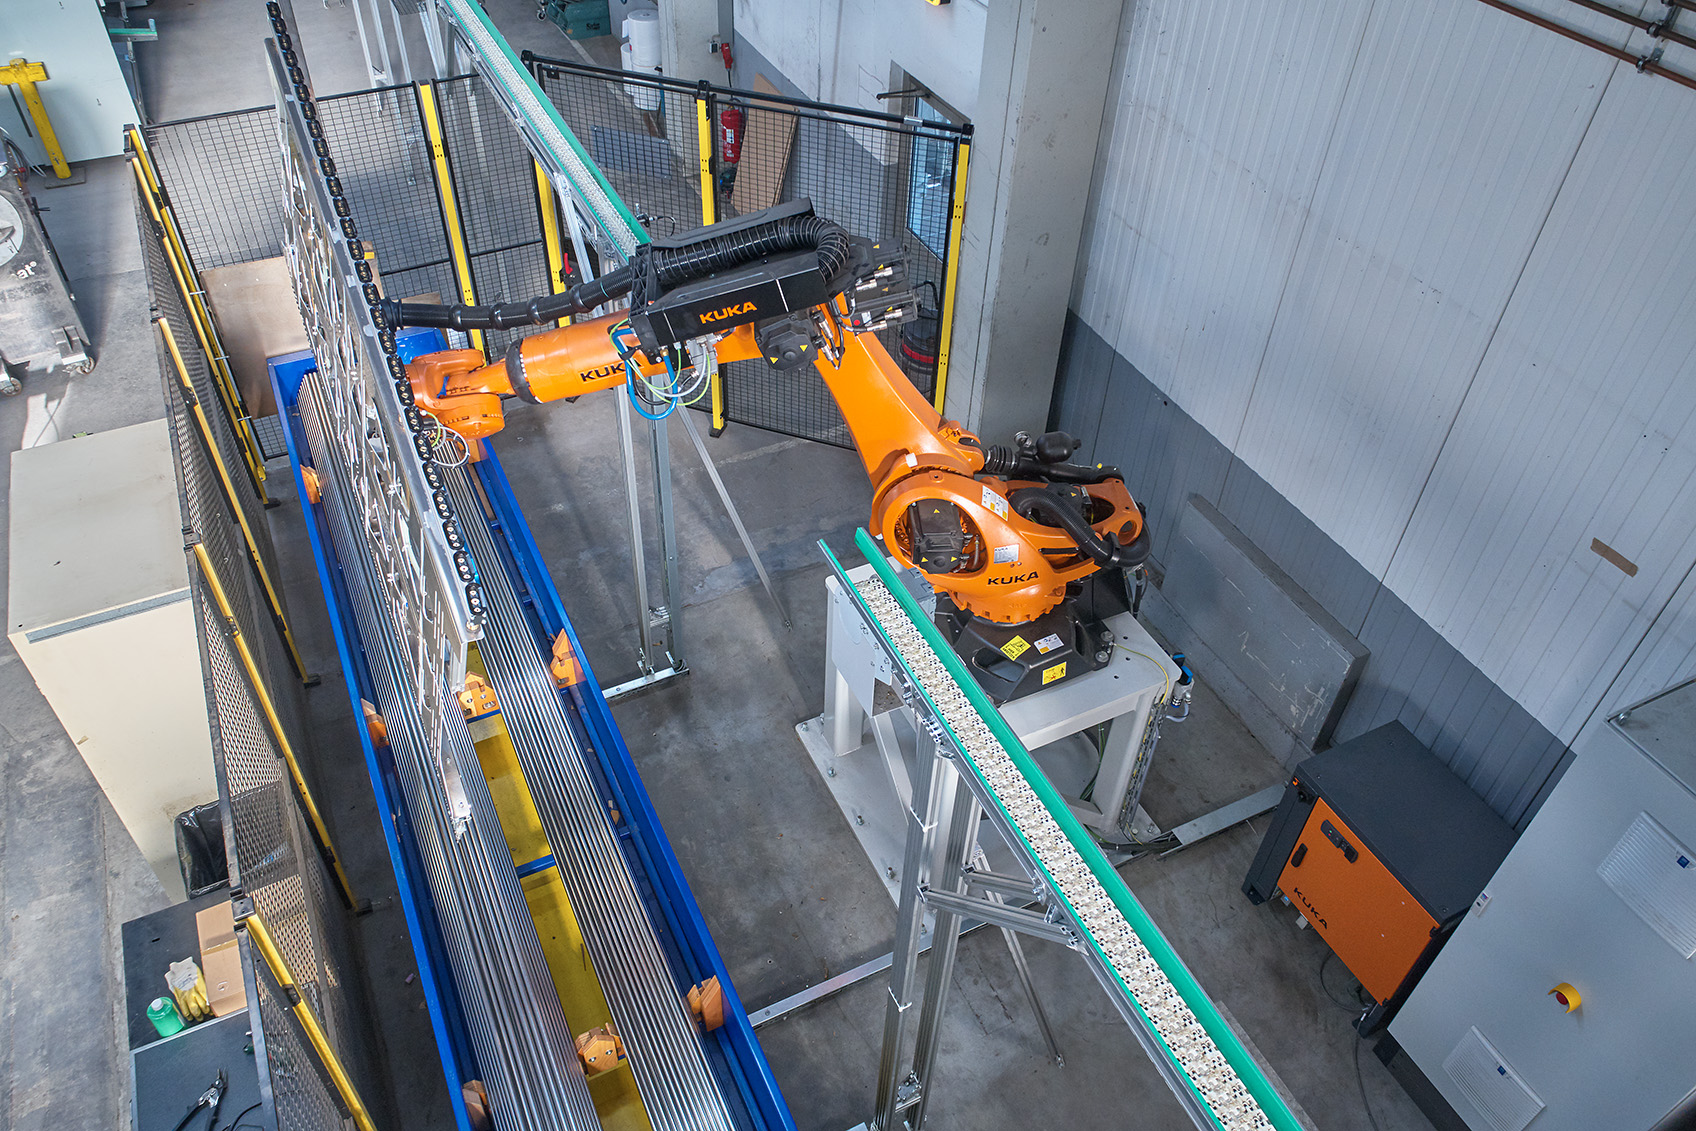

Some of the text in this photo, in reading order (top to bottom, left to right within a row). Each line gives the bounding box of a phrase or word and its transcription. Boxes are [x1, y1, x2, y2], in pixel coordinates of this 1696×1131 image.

[699, 301, 758, 324] KUKA
[988, 571, 1039, 585] KUKA
[1293, 887, 1328, 929] KUKA
